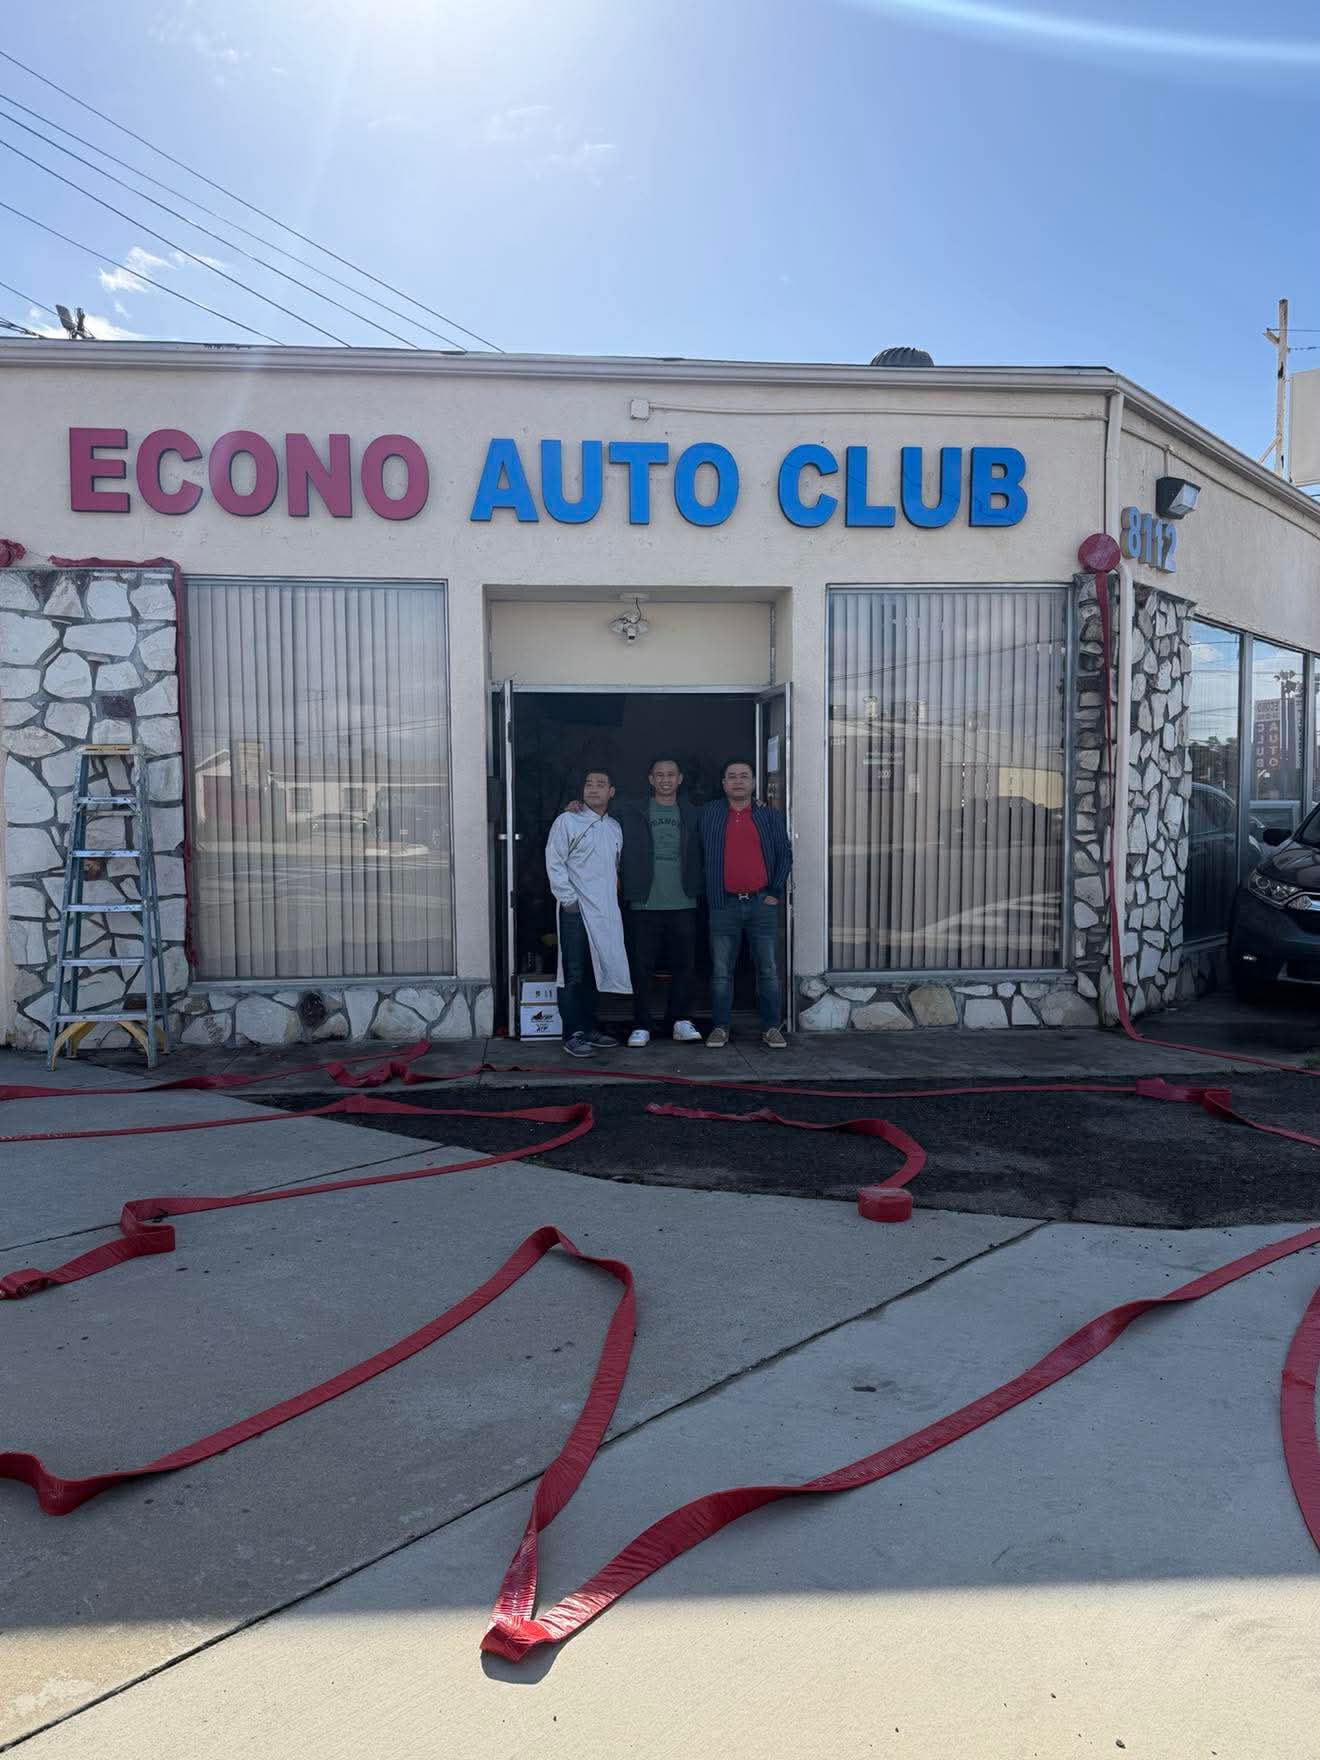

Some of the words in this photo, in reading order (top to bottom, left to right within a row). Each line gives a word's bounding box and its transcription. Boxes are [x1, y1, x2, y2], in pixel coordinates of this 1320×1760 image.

[69, 427, 428, 520] ECONO
[470, 438, 740, 527] AUTO
[778, 444, 1028, 529] CLUB
[1121, 506, 1177, 573] 8112
